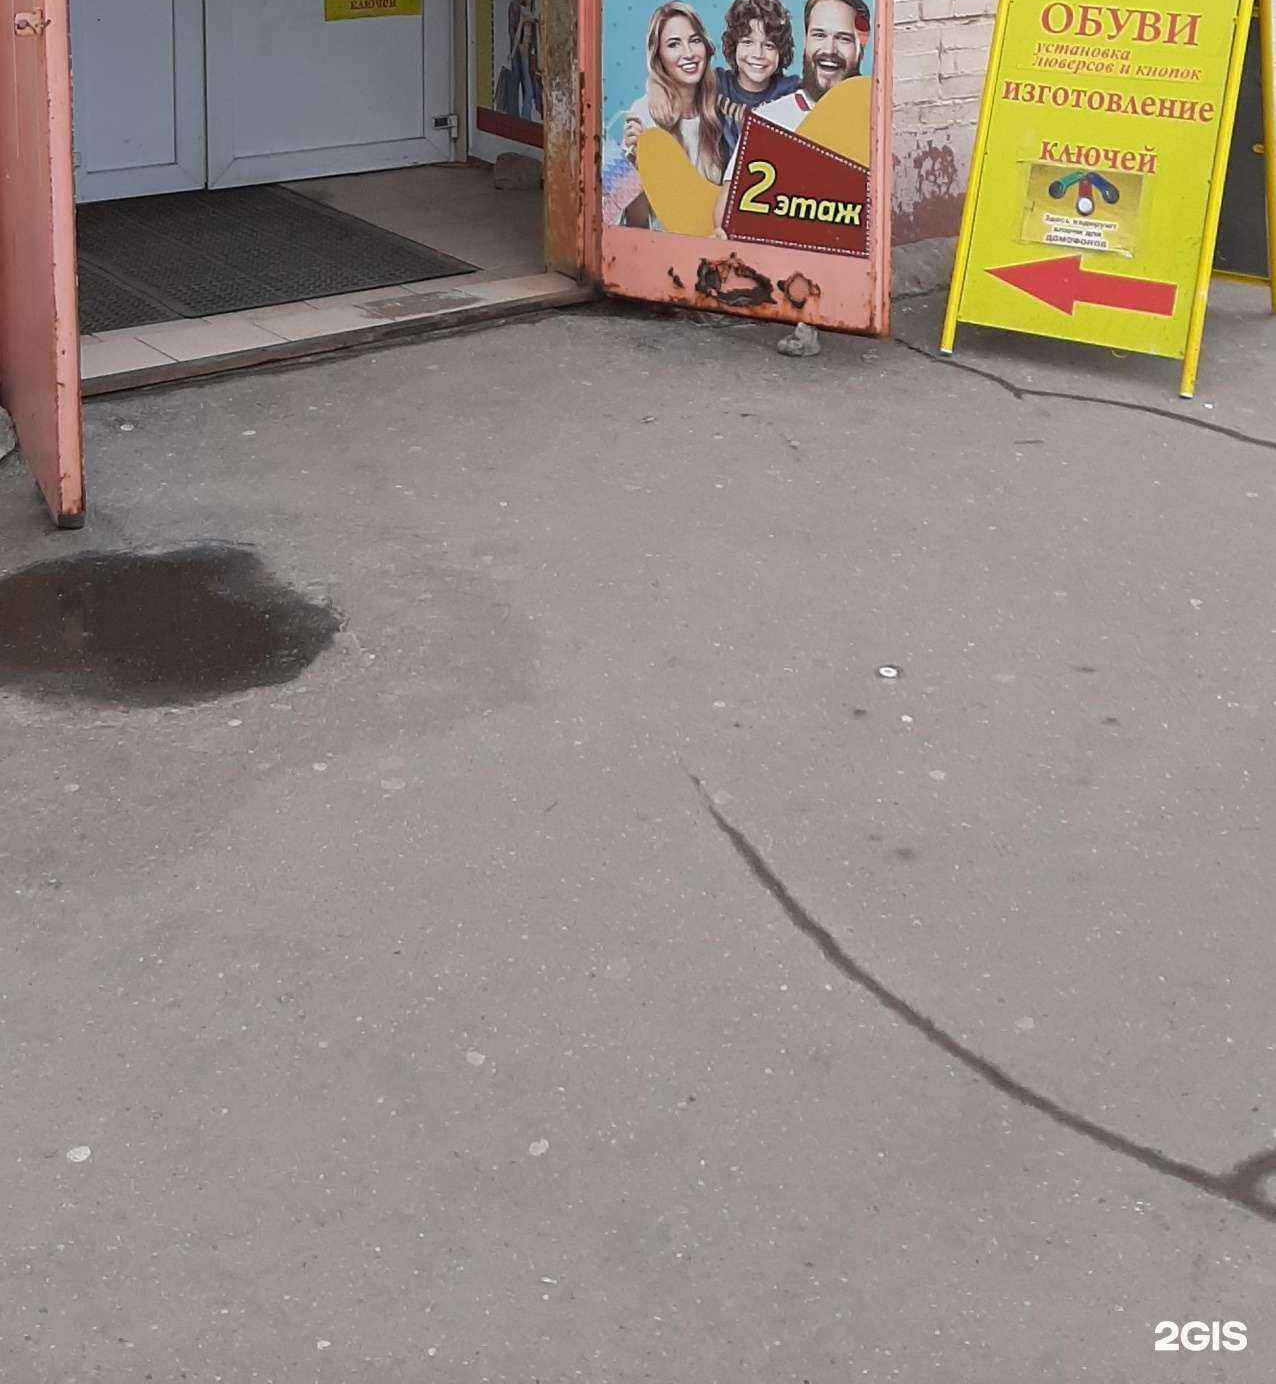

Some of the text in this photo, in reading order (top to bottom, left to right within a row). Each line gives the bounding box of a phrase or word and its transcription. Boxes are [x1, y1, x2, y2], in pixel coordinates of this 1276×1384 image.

[1041, 1, 1202, 47] ОБУВИ
[1034, 42, 1131, 61] установка
[1119, 65, 1130, 75] и
[1136, 65, 1202, 81] кнопок
[1002, 80, 1215, 123] изготовление
[1040, 141, 1158, 174] ключей
[738, 161, 863, 225] 2 этаж
